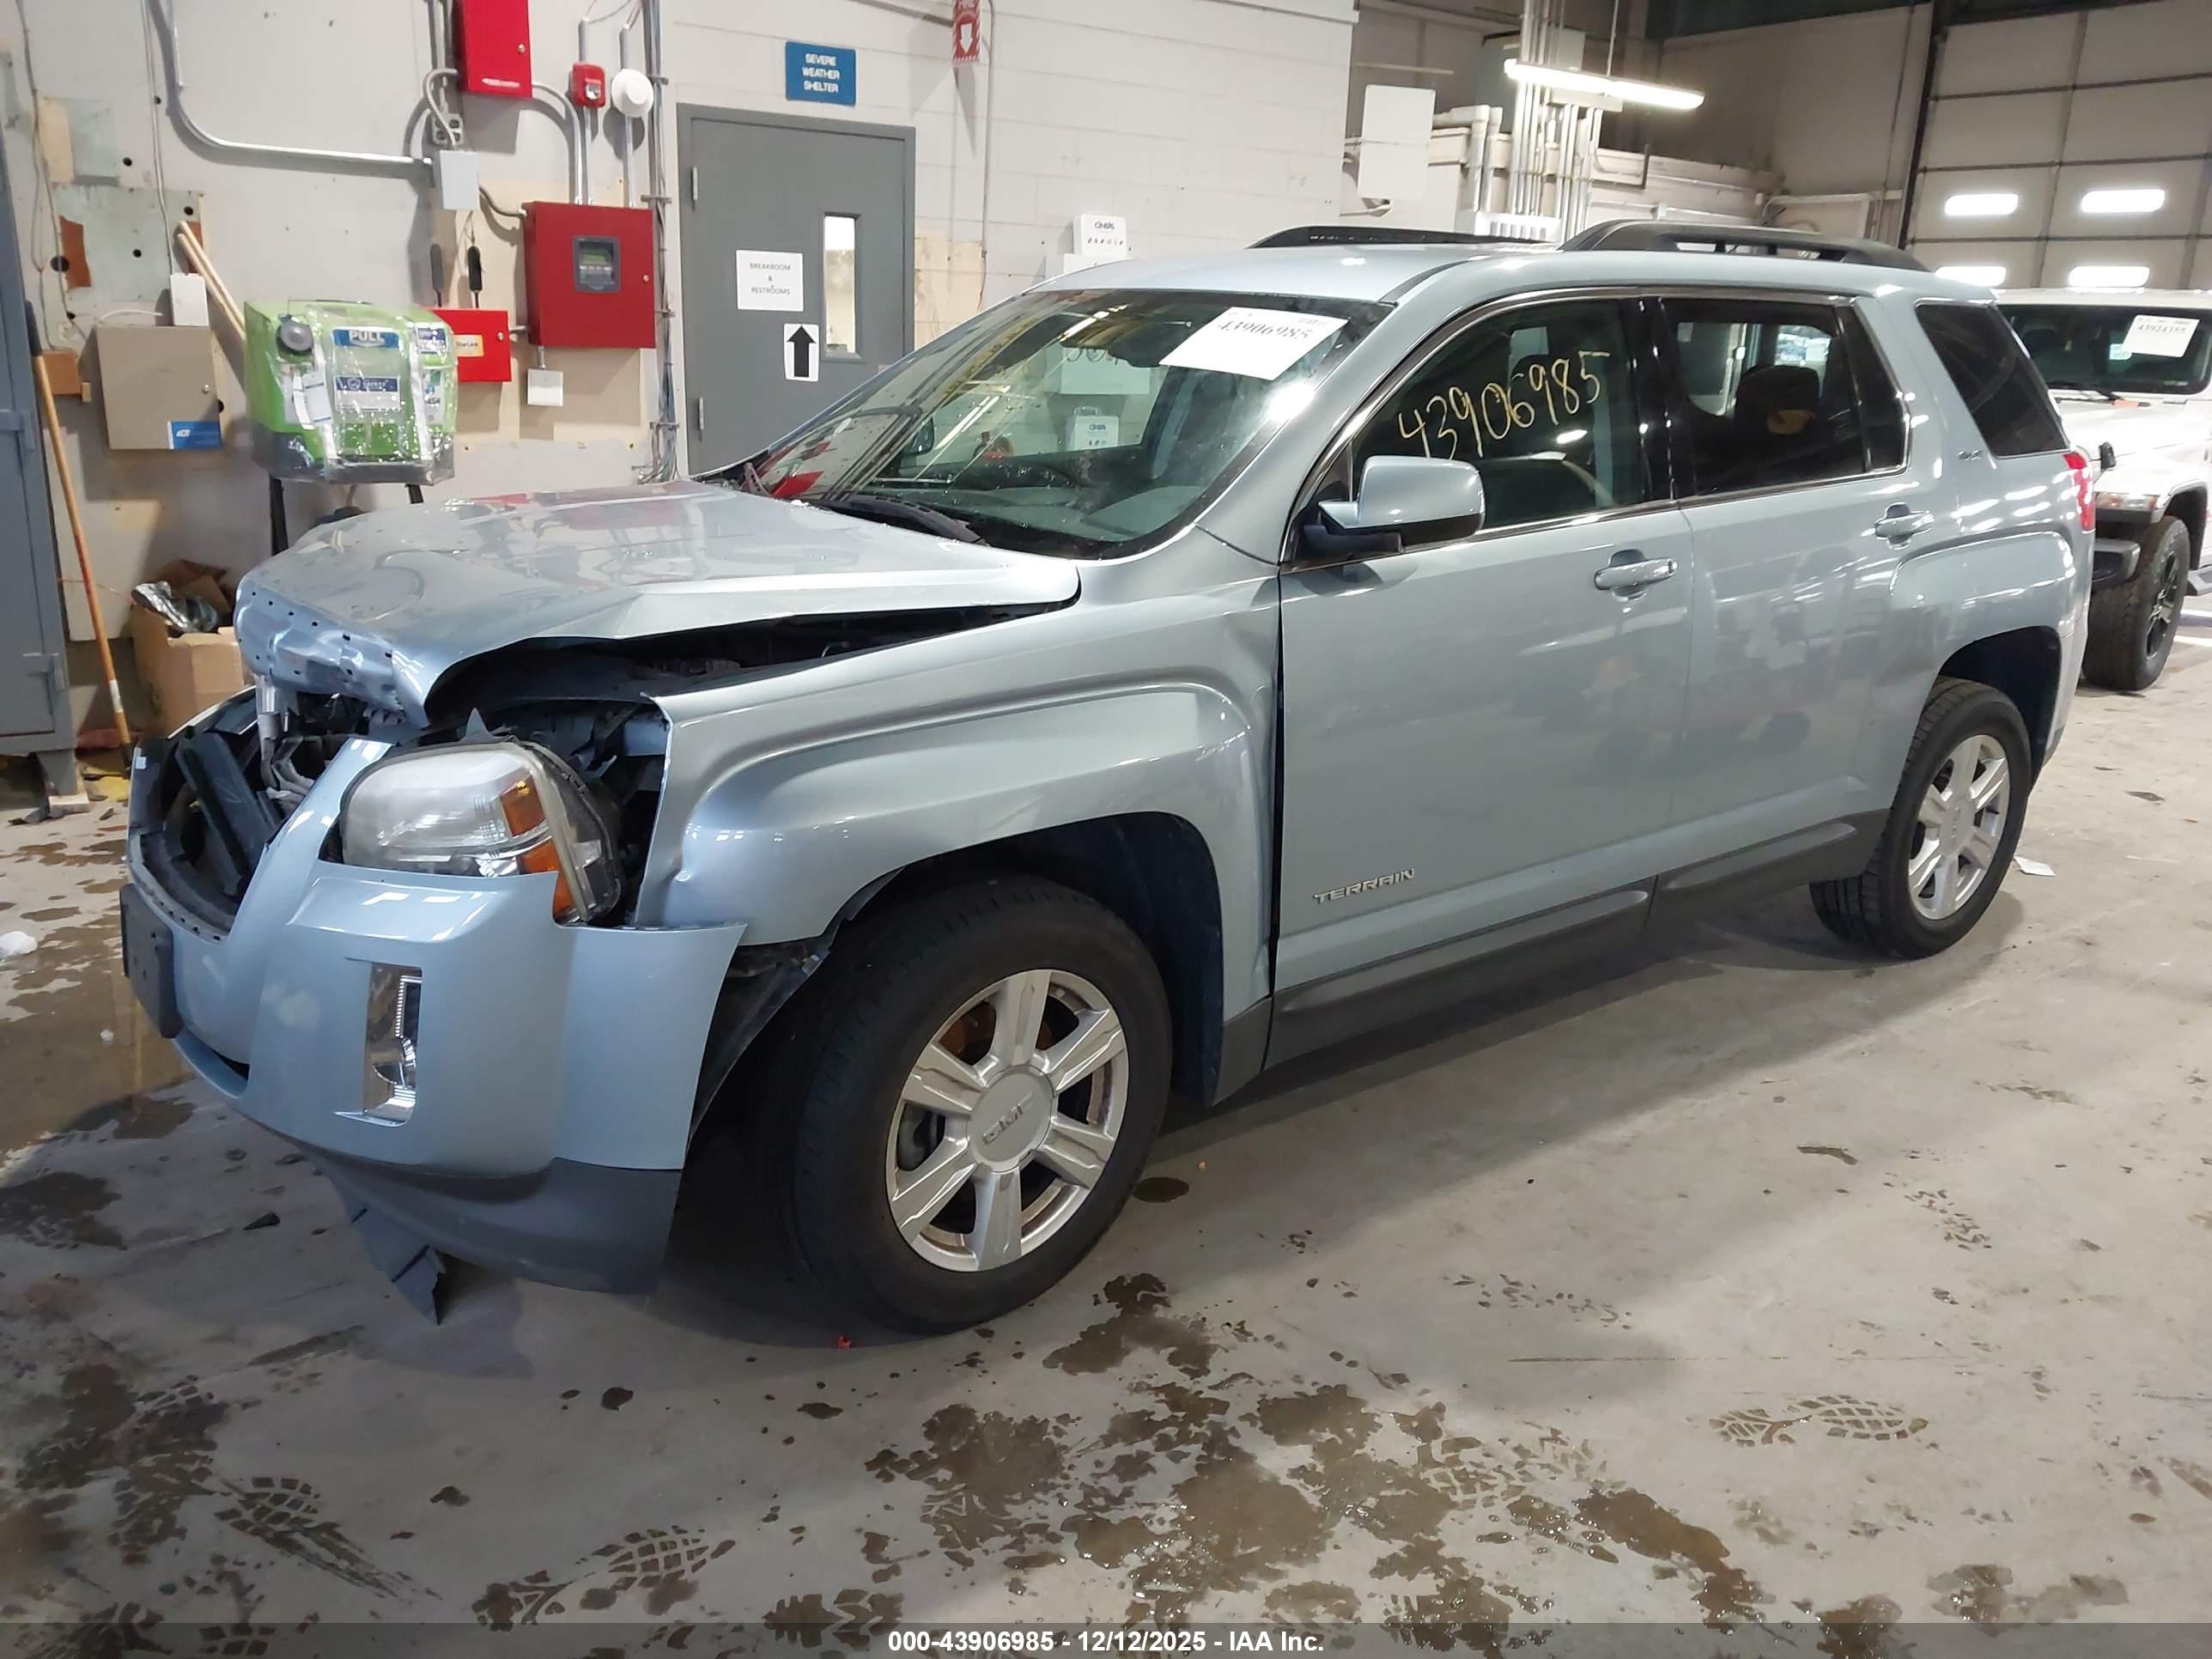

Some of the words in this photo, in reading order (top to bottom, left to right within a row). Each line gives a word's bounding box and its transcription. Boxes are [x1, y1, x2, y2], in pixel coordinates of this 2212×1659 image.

[805, 53, 836, 66] SEVERE
[802, 67, 840, 80] WEATHER
[804, 80, 839, 93] SHELTER
[349, 330, 385, 342] PULL
[1398, 350, 1611, 460] 43906985
[1313, 866, 1415, 904] TERRAIN
[982, 1091, 1035, 1146] GMC
